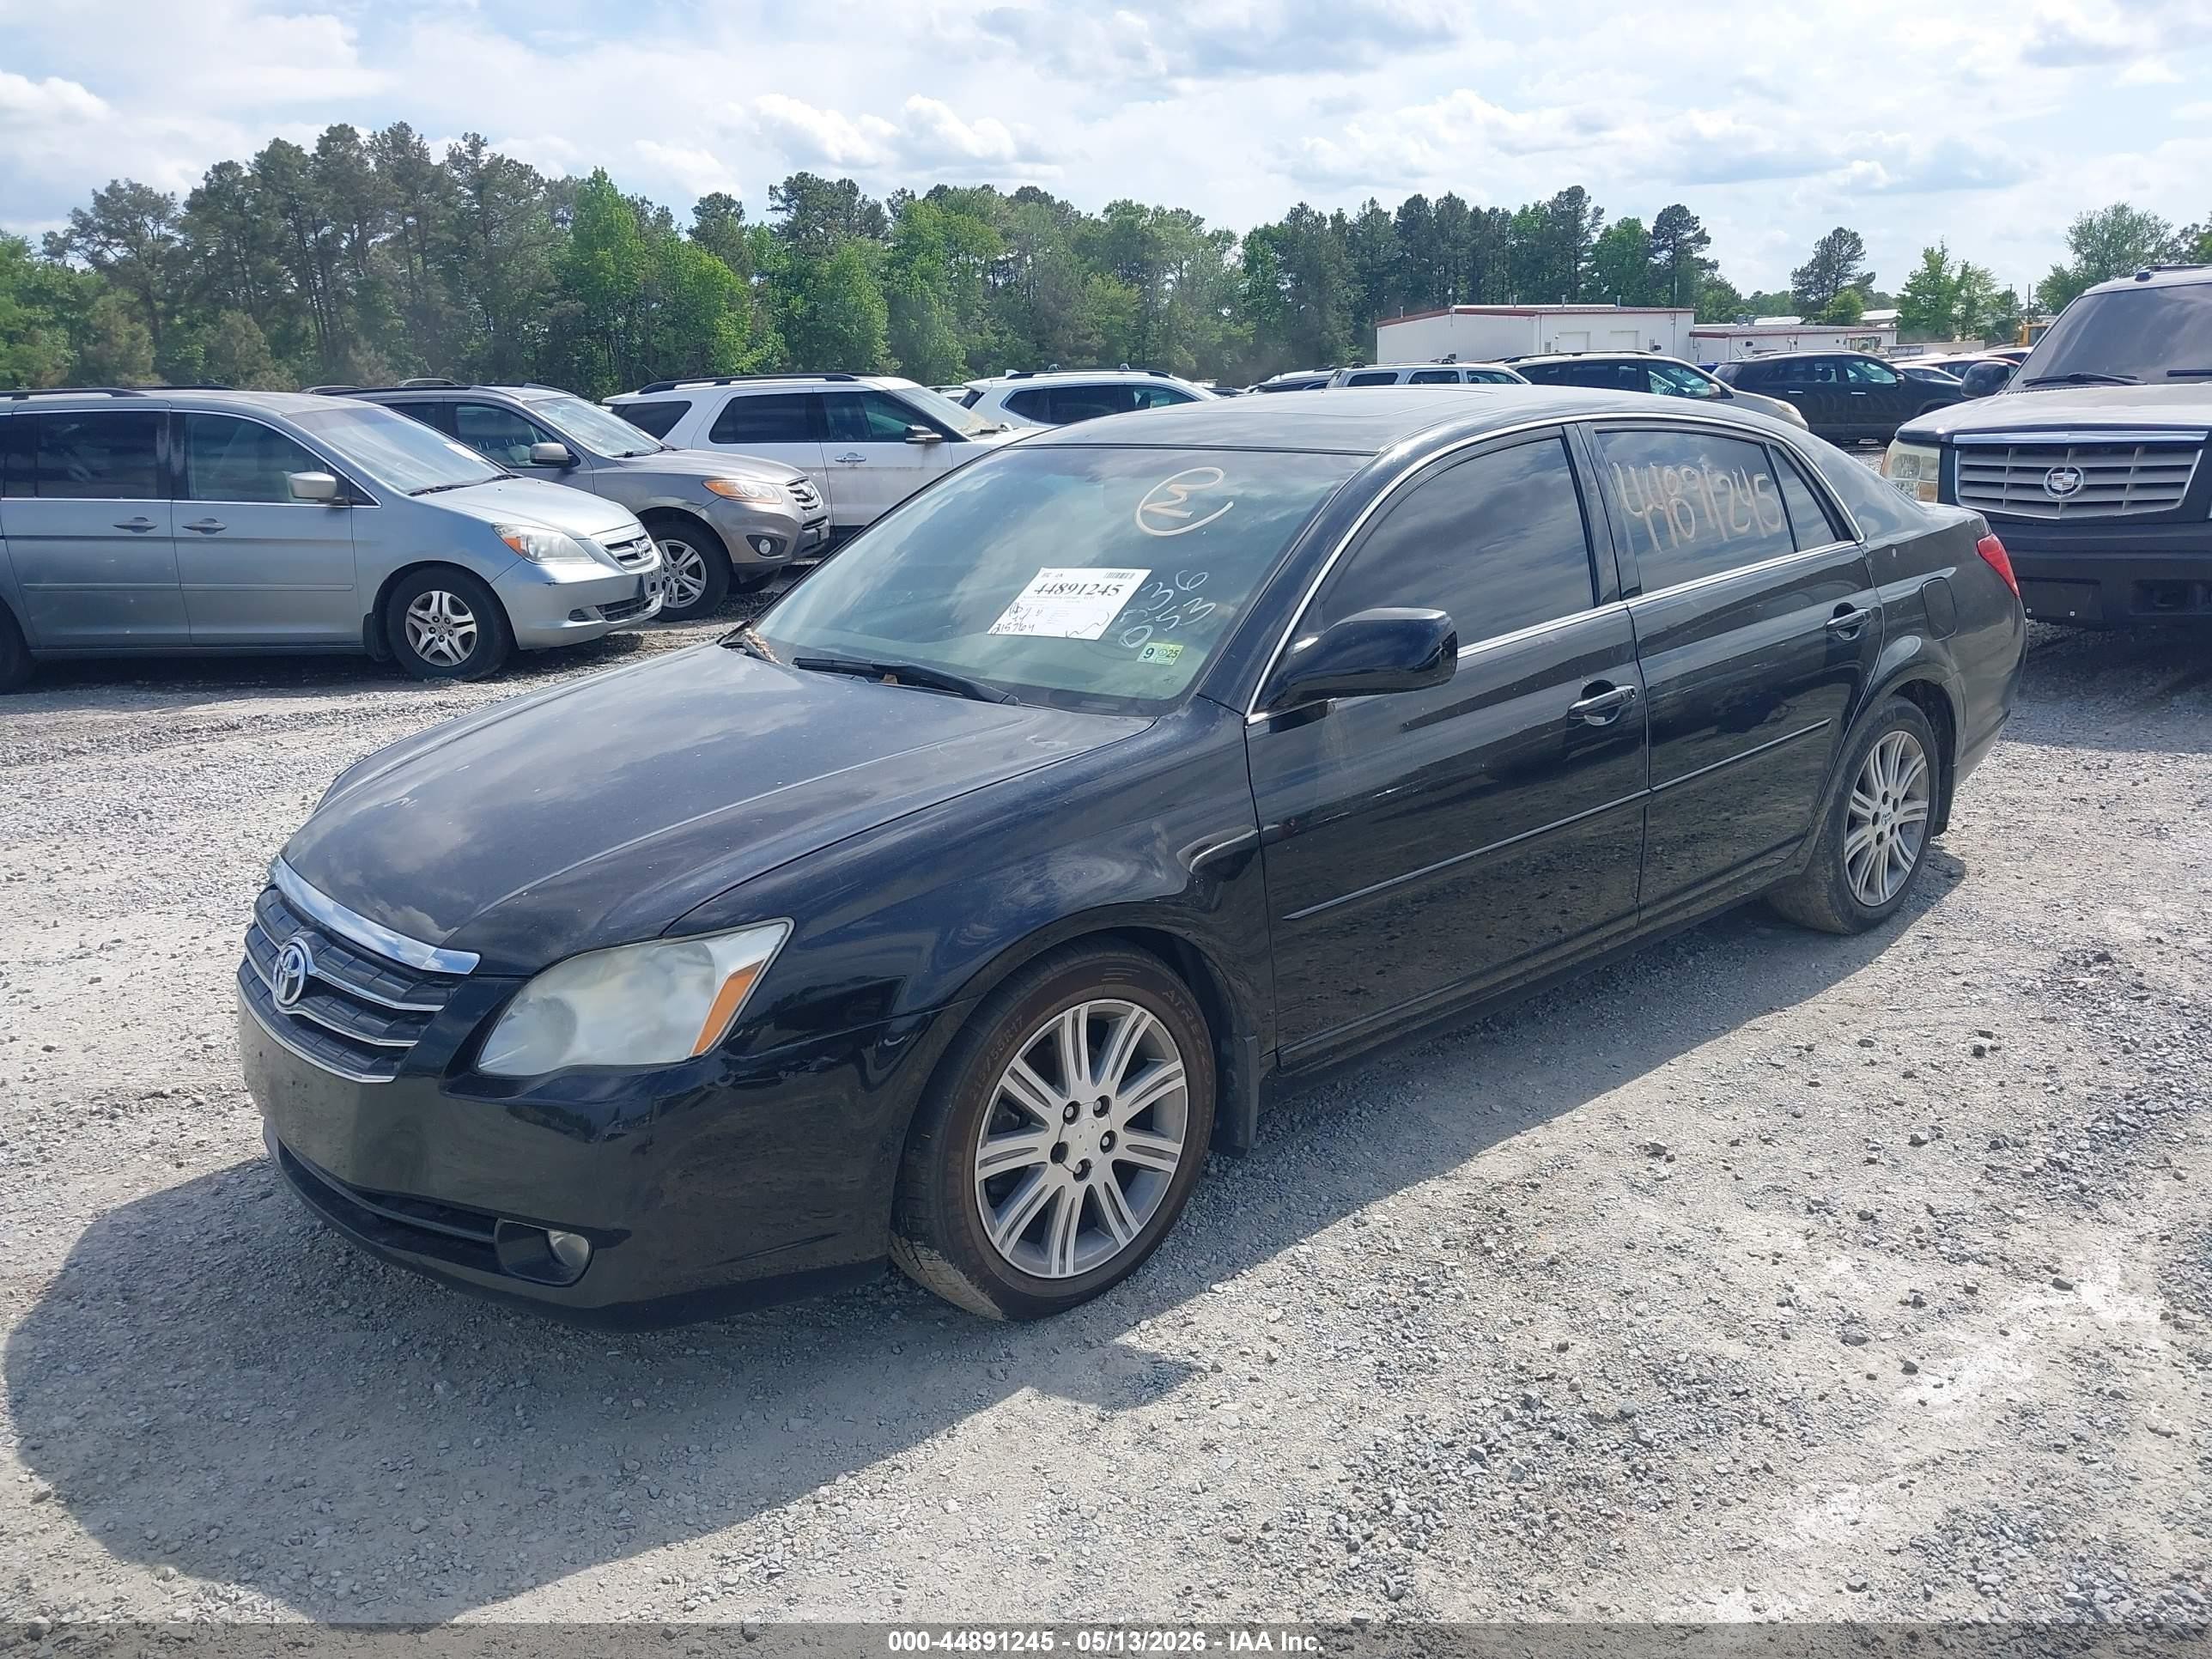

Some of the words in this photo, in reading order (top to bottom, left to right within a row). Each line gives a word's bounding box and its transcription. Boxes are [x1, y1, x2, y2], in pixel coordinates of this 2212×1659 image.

[1612, 454, 1782, 552] 44891245
[1035, 582, 1124, 596] 44891245
[1143, 647, 1155, 659] 9
[1166, 649, 1180, 659] 25
